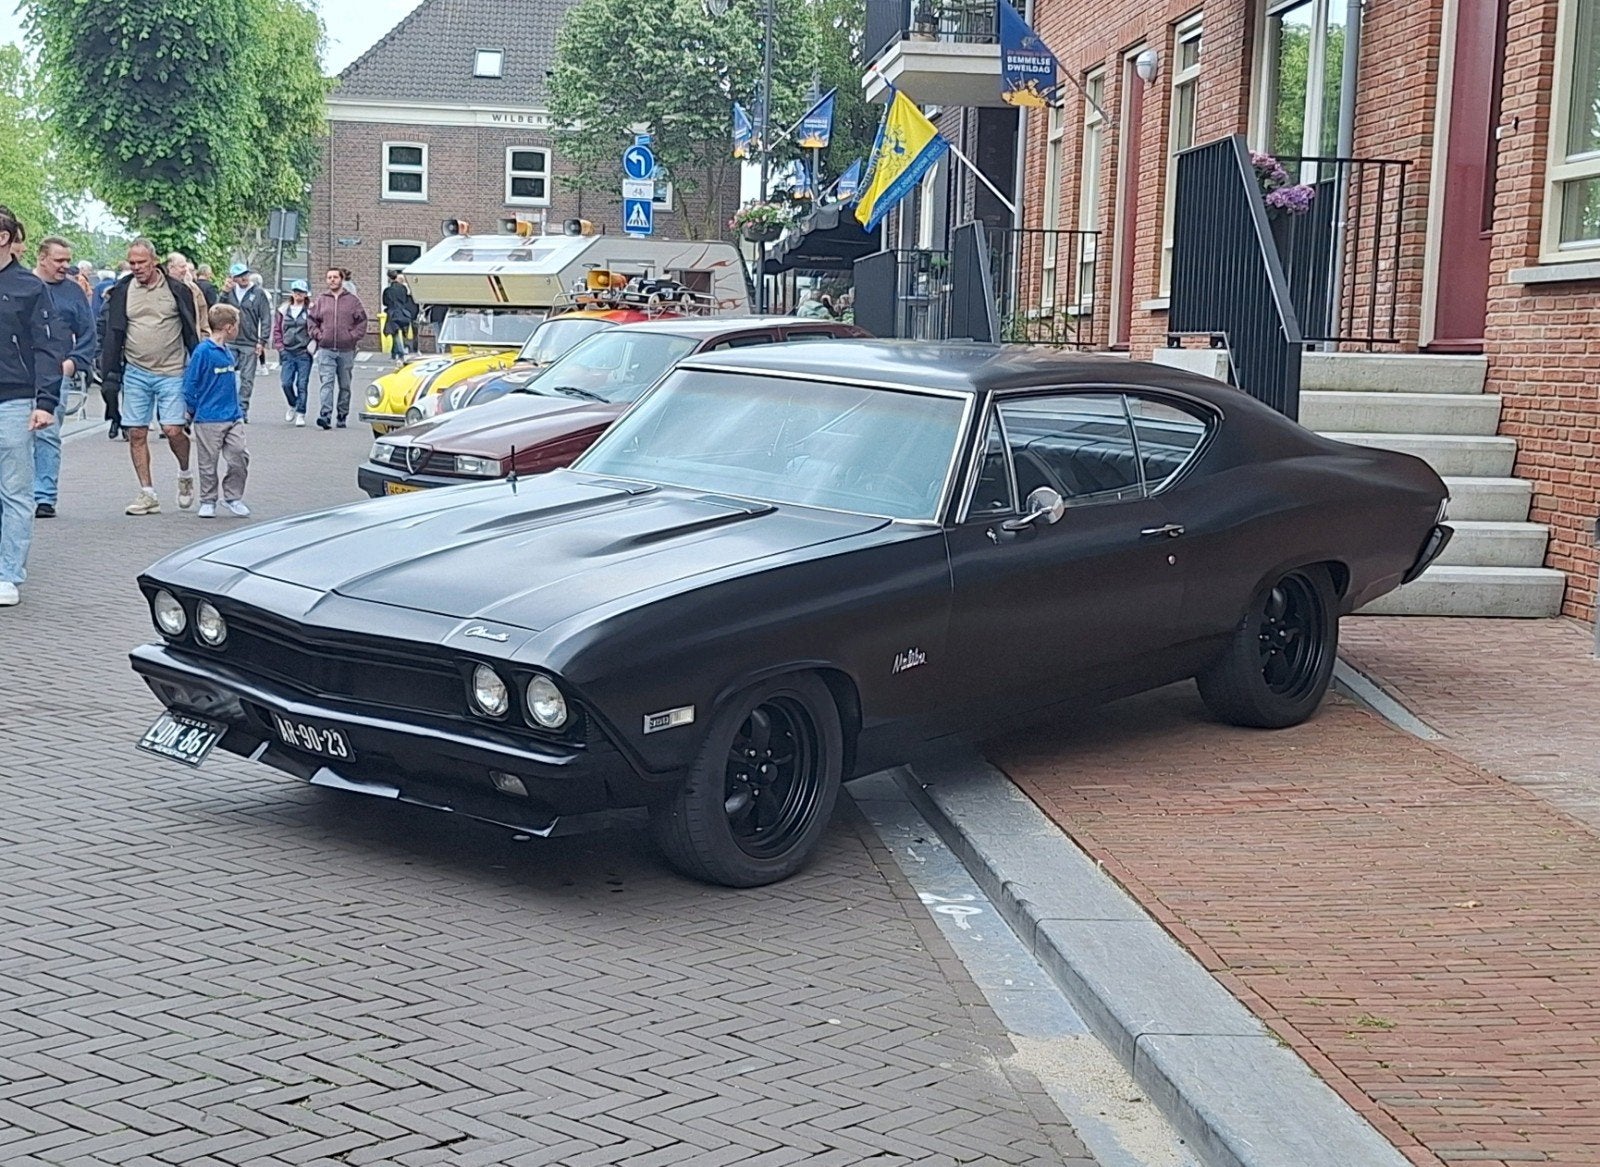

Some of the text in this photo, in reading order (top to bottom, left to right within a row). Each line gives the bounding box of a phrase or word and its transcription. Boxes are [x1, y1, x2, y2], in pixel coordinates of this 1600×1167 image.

[1007, 56, 1051, 66] BEMMELSE
[1007, 64, 1051, 74] DWEILDAG
[891, 647, 928, 674] Malibu
[181, 717, 209, 729] TEXAS
[274, 713, 348, 758] AR-90-23
